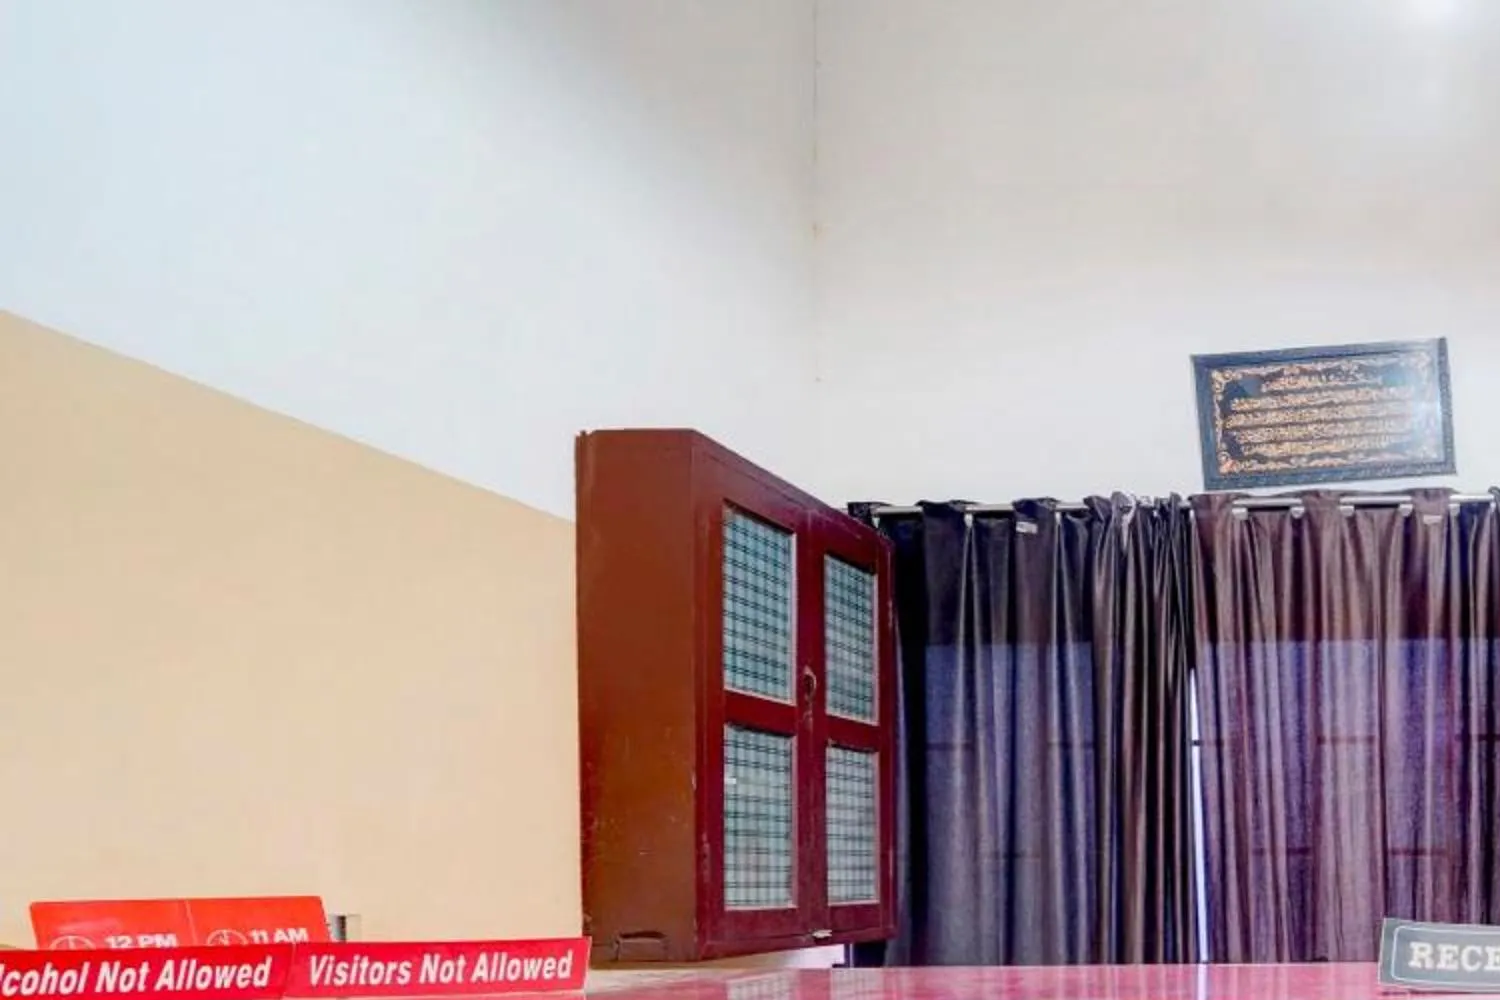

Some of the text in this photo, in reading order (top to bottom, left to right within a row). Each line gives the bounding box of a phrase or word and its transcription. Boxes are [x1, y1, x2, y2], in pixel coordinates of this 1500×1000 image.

[104, 933, 178, 949] 12 PM
[250, 927, 309, 944] 11 AM
[95, 960, 150, 993] Not
[154, 956, 272, 991] Allowed
[309, 949, 574, 987] Visitors Not Allowed
